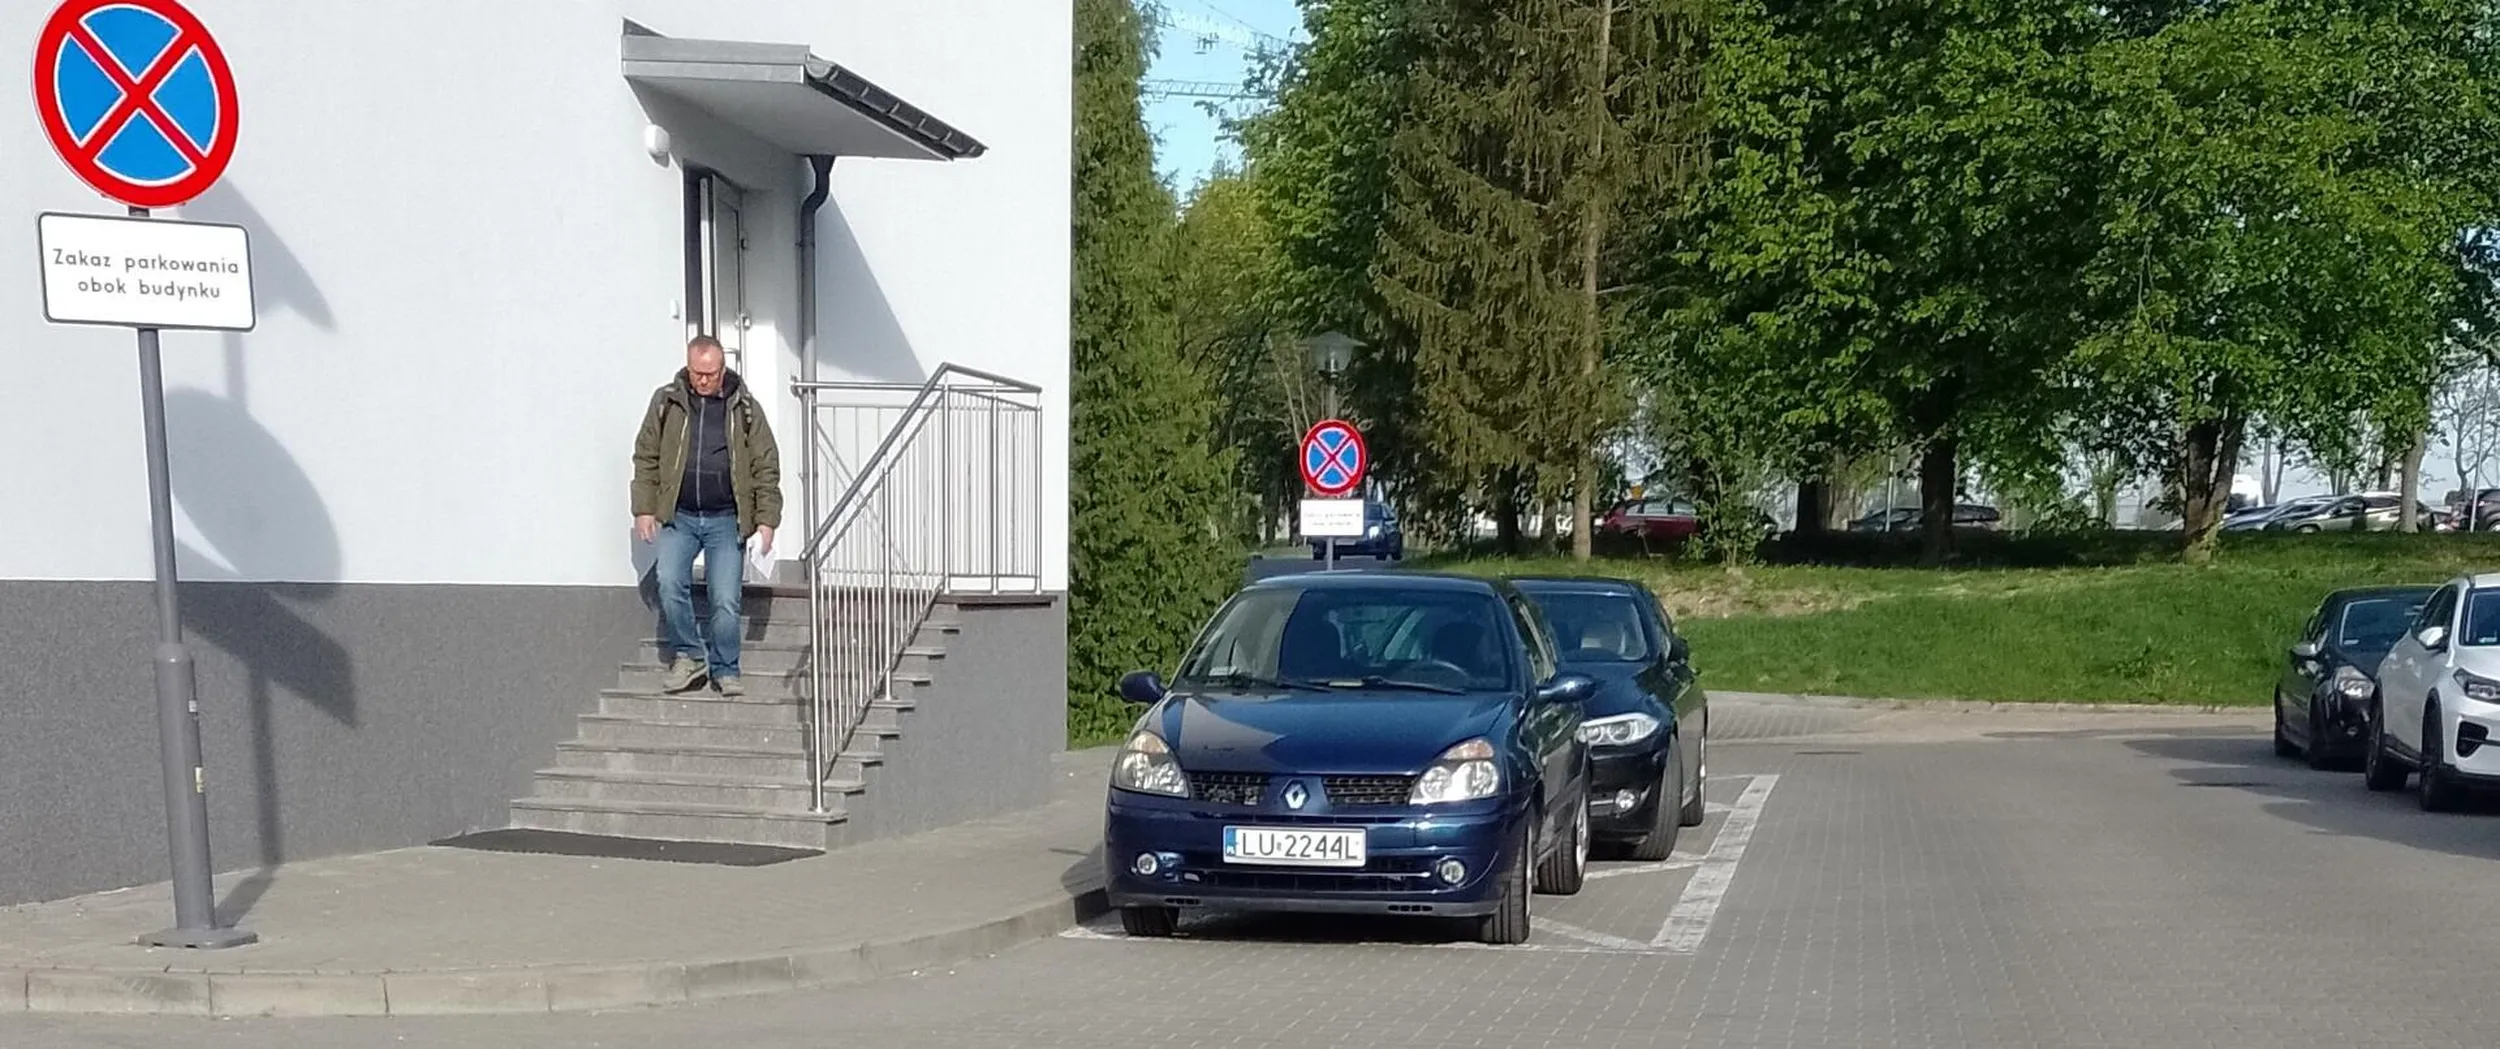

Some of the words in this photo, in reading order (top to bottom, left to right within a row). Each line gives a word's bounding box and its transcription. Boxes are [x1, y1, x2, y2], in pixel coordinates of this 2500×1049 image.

[53, 248, 112, 268] Zakaz
[125, 254, 239, 274] parkowania
[78, 277, 126, 294] obok
[139, 279, 220, 301] budynku
[1242, 832, 1274, 856] LU
[1284, 834, 1358, 859] 2244L
